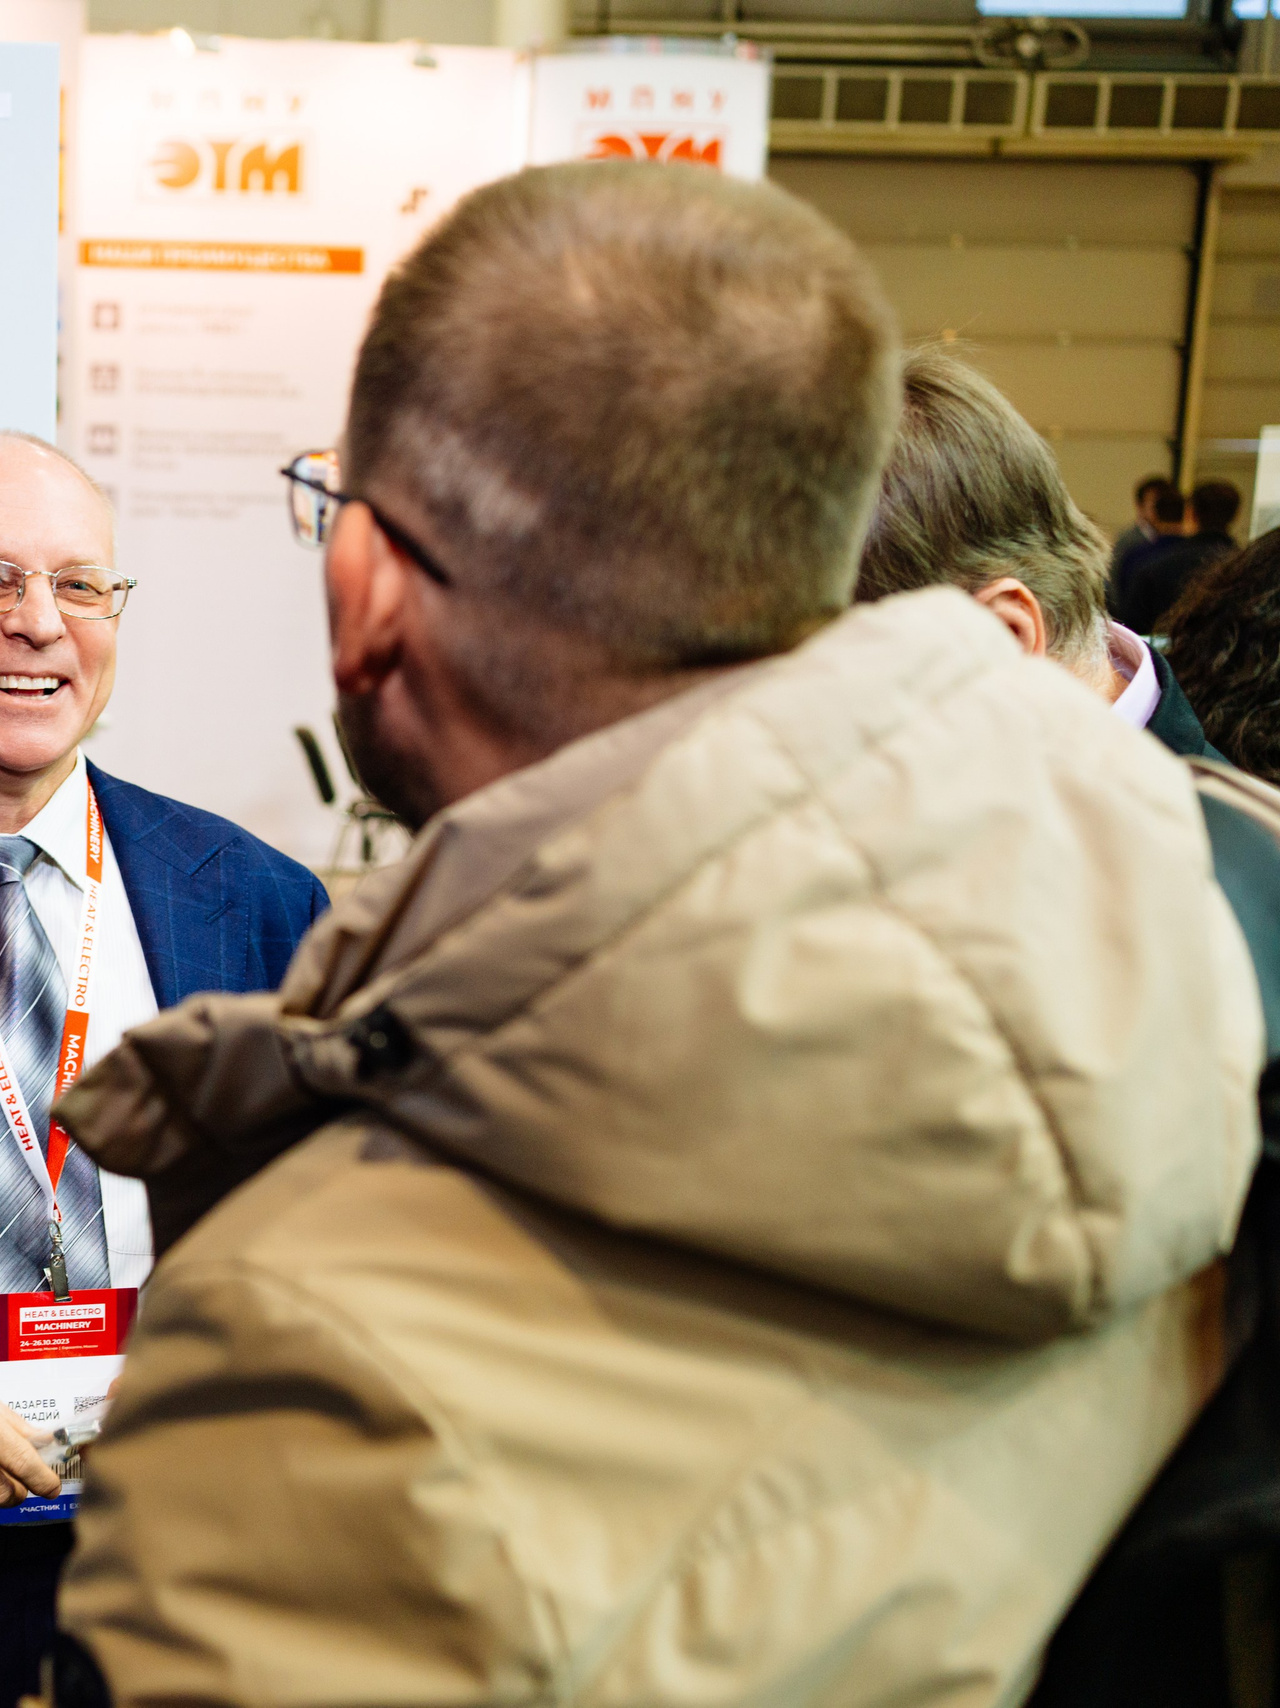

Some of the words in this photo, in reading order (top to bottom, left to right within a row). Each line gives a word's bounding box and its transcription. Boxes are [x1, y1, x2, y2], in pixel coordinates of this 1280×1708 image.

[87, 884, 97, 921] HEAT
[74, 937, 94, 1007] ELECTRO
[5, 1094, 17, 1105] &
[9, 1109, 34, 1151] HEAT
[24, 1310, 49, 1319] HEAT
[59, 1307, 102, 1317] ELECTRO
[34, 1321, 91, 1331] MACHINERY
[19, 1504, 61, 1513] УЧАСТНИК
